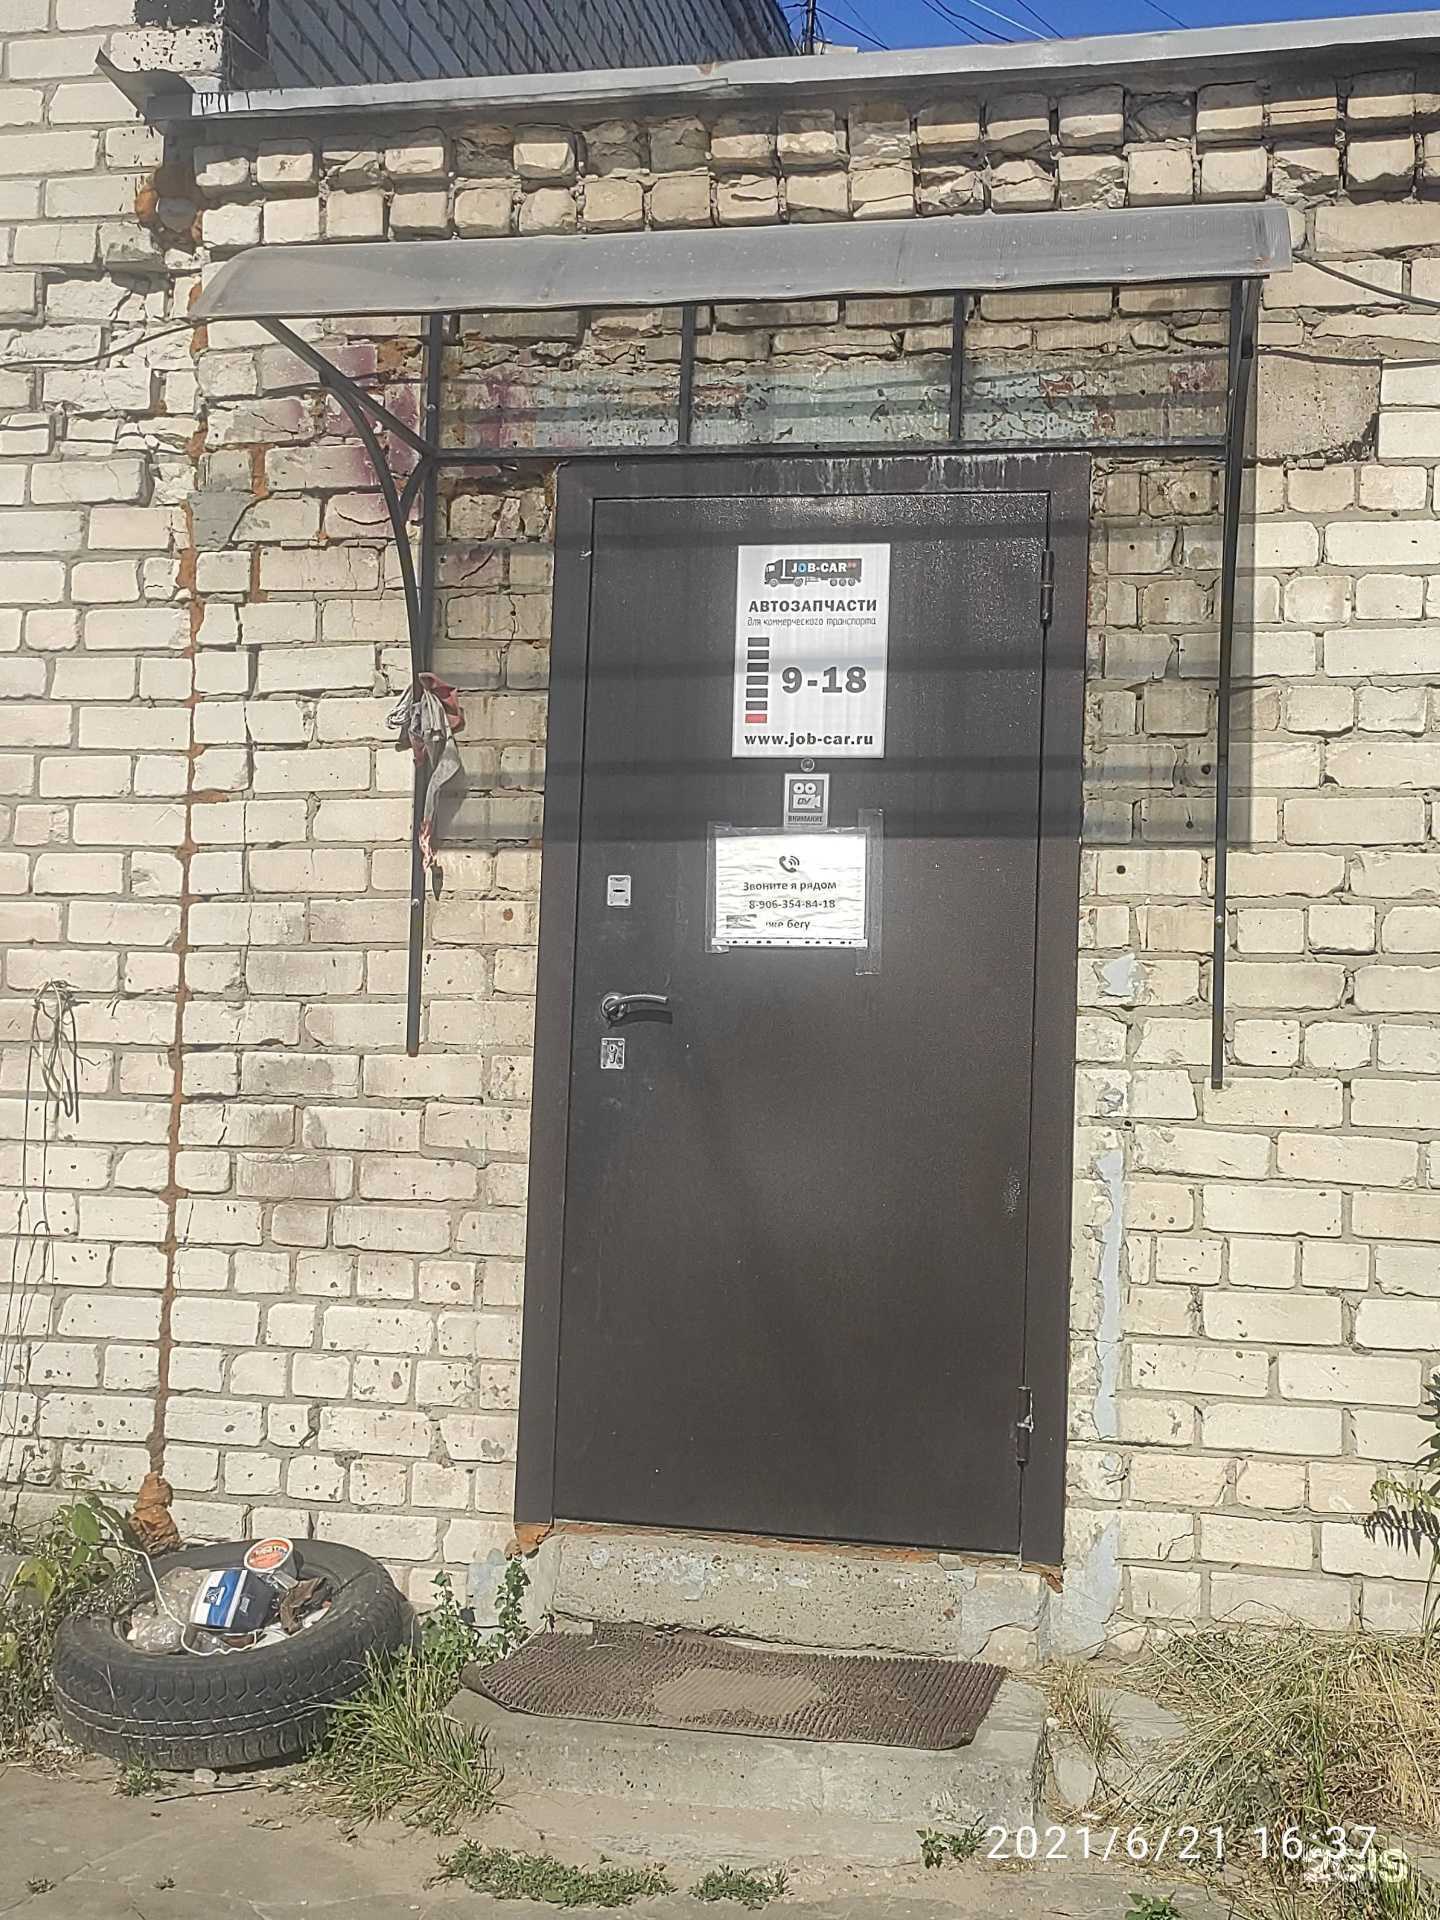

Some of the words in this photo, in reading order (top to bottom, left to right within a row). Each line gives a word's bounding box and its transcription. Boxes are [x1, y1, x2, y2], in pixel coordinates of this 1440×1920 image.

[791, 562, 847, 573] JOB-CAR
[748, 599, 877, 613] АВТОЗАПЧАСТИ
[763, 617, 824, 628] коммерческого
[826, 617, 877, 628] транспорта
[782, 666, 867, 694] 9-18
[744, 732, 873, 747] www.job-car.ru
[744, 882, 788, 891] Звоните
[800, 881, 837, 892] рядом
[749, 899, 836, 910] 8-906-354-84-18
[787, 919, 810, 931] бегу
